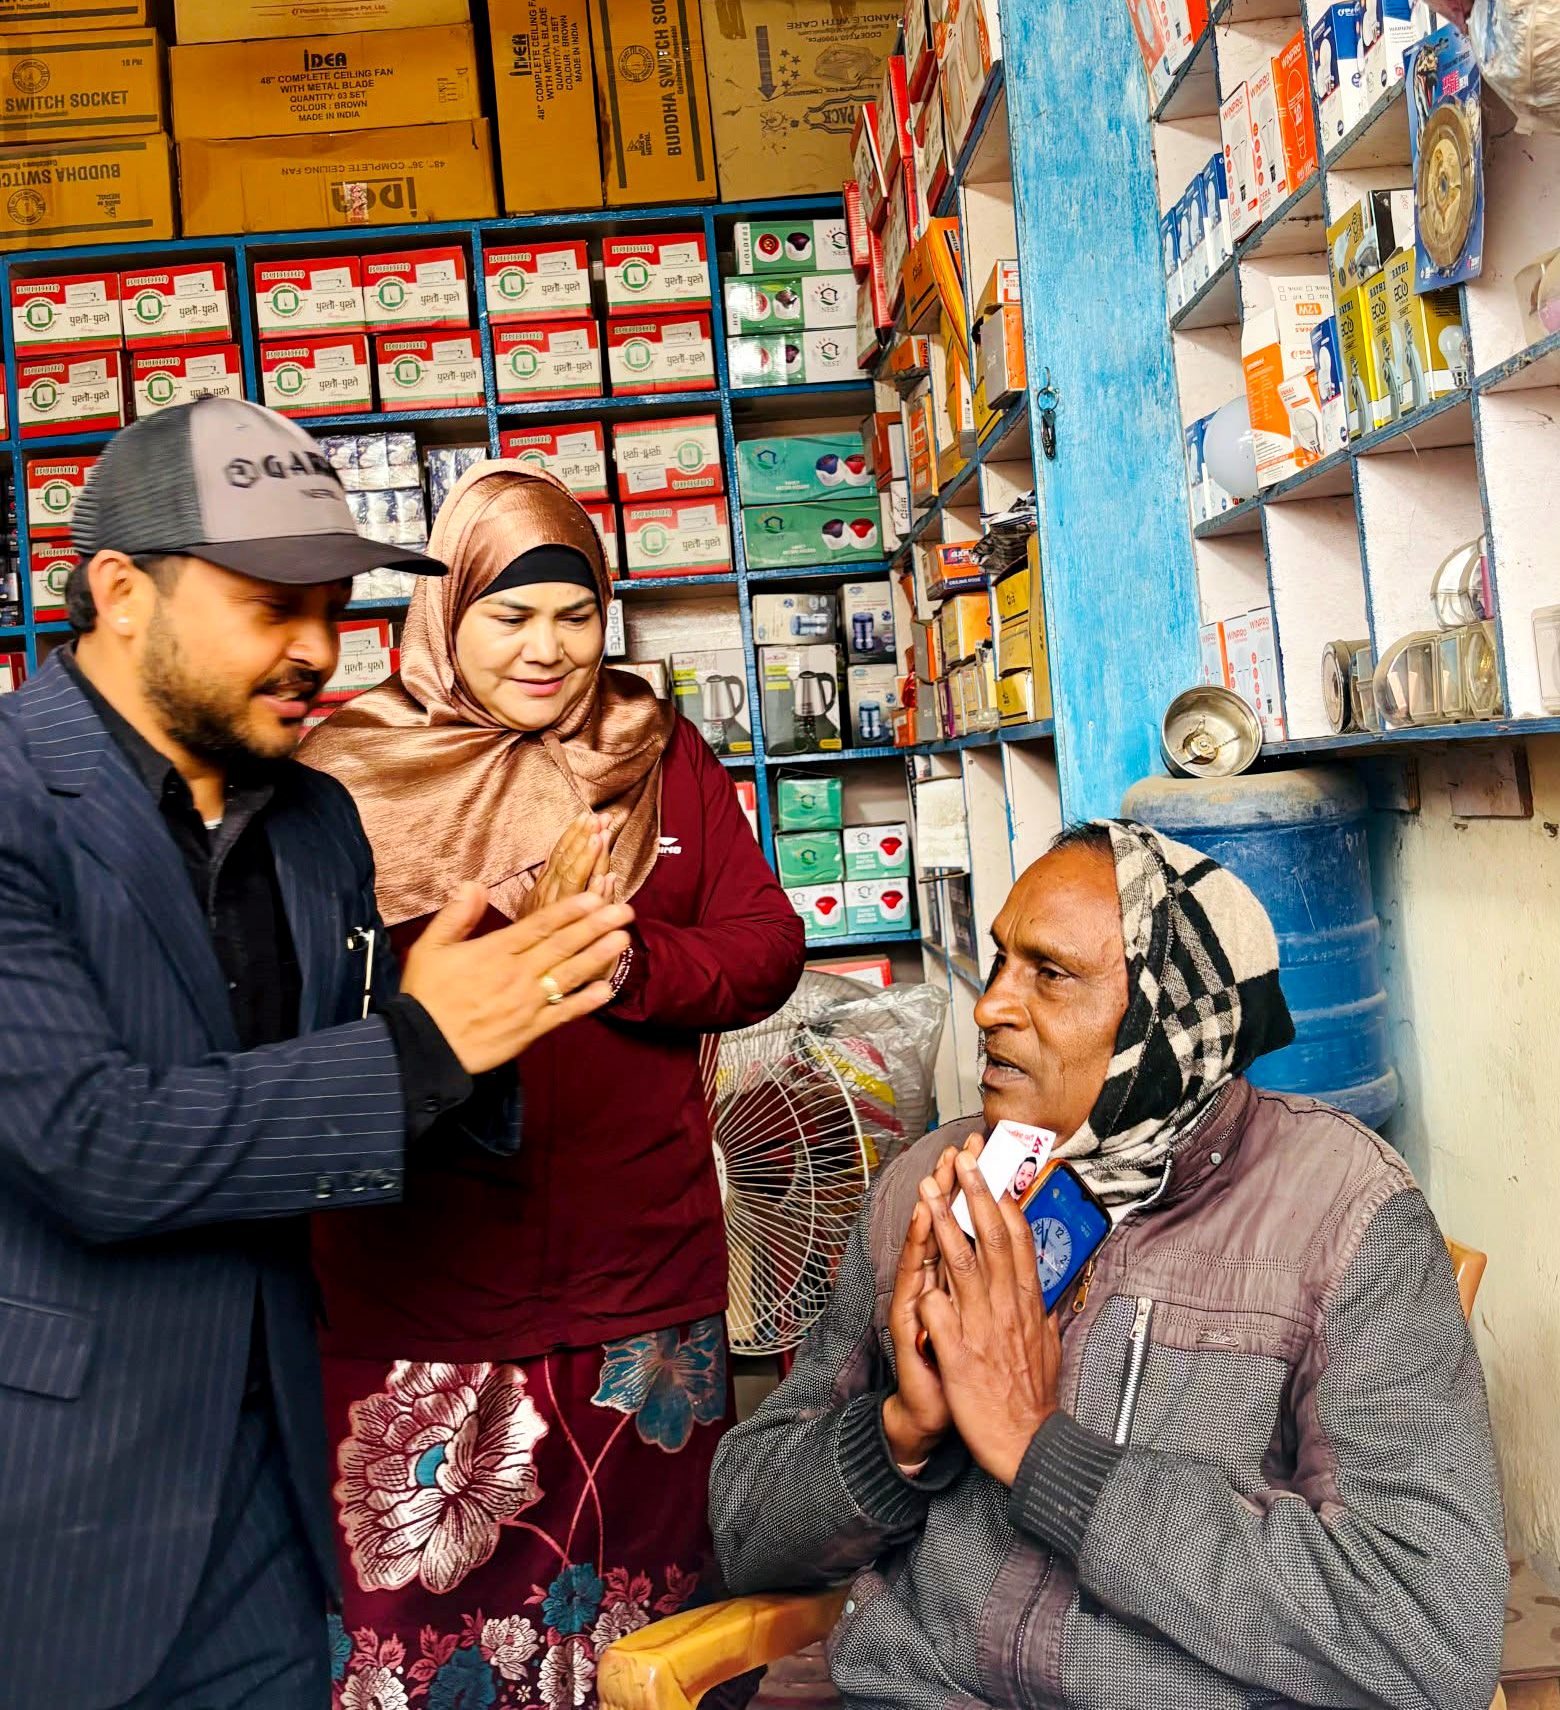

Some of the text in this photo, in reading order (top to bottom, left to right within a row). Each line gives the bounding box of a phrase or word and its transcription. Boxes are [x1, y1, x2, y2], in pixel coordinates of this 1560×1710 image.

[529, 9, 539, 47] CEILING
[786, 20, 818, 30] CARE
[852, 14, 899, 24] HANDLE
[559, 15, 569, 47] BROWN
[539, 7, 554, 100] WITH METAL BLADE
[570, 22, 582, 82] MADE IN INDIA
[654, 29, 675, 88] SWITCH
[277, 72, 331, 83] COMPLETE
[333, 69, 373, 80] CEILING
[374, 67, 394, 77] FAN
[532, 50, 544, 102] COMPLETE
[563, 54, 573, 91] COLOUR
[280, 79, 375, 93] WITH METAL BLADE
[337, 91, 348, 100] 03
[350, 90, 366, 99] SET
[5, 90, 129, 113] SWITCH SOCKET
[289, 102, 328, 112] COLOUR
[334, 100, 368, 110] BROWN
[299, 110, 360, 122] MADE IN INDIA
[661, 92, 682, 156] BUDDHA
[823, 105, 856, 125] PACK
[57, 164, 121, 182] BUDDHA
[281, 167, 301, 176] FAN
[303, 164, 346, 174] CEILING
[348, 162, 404, 173] COMPLETE
[0, 169, 51, 187] SWITC
[1055, 1227, 1065, 1239] 12
